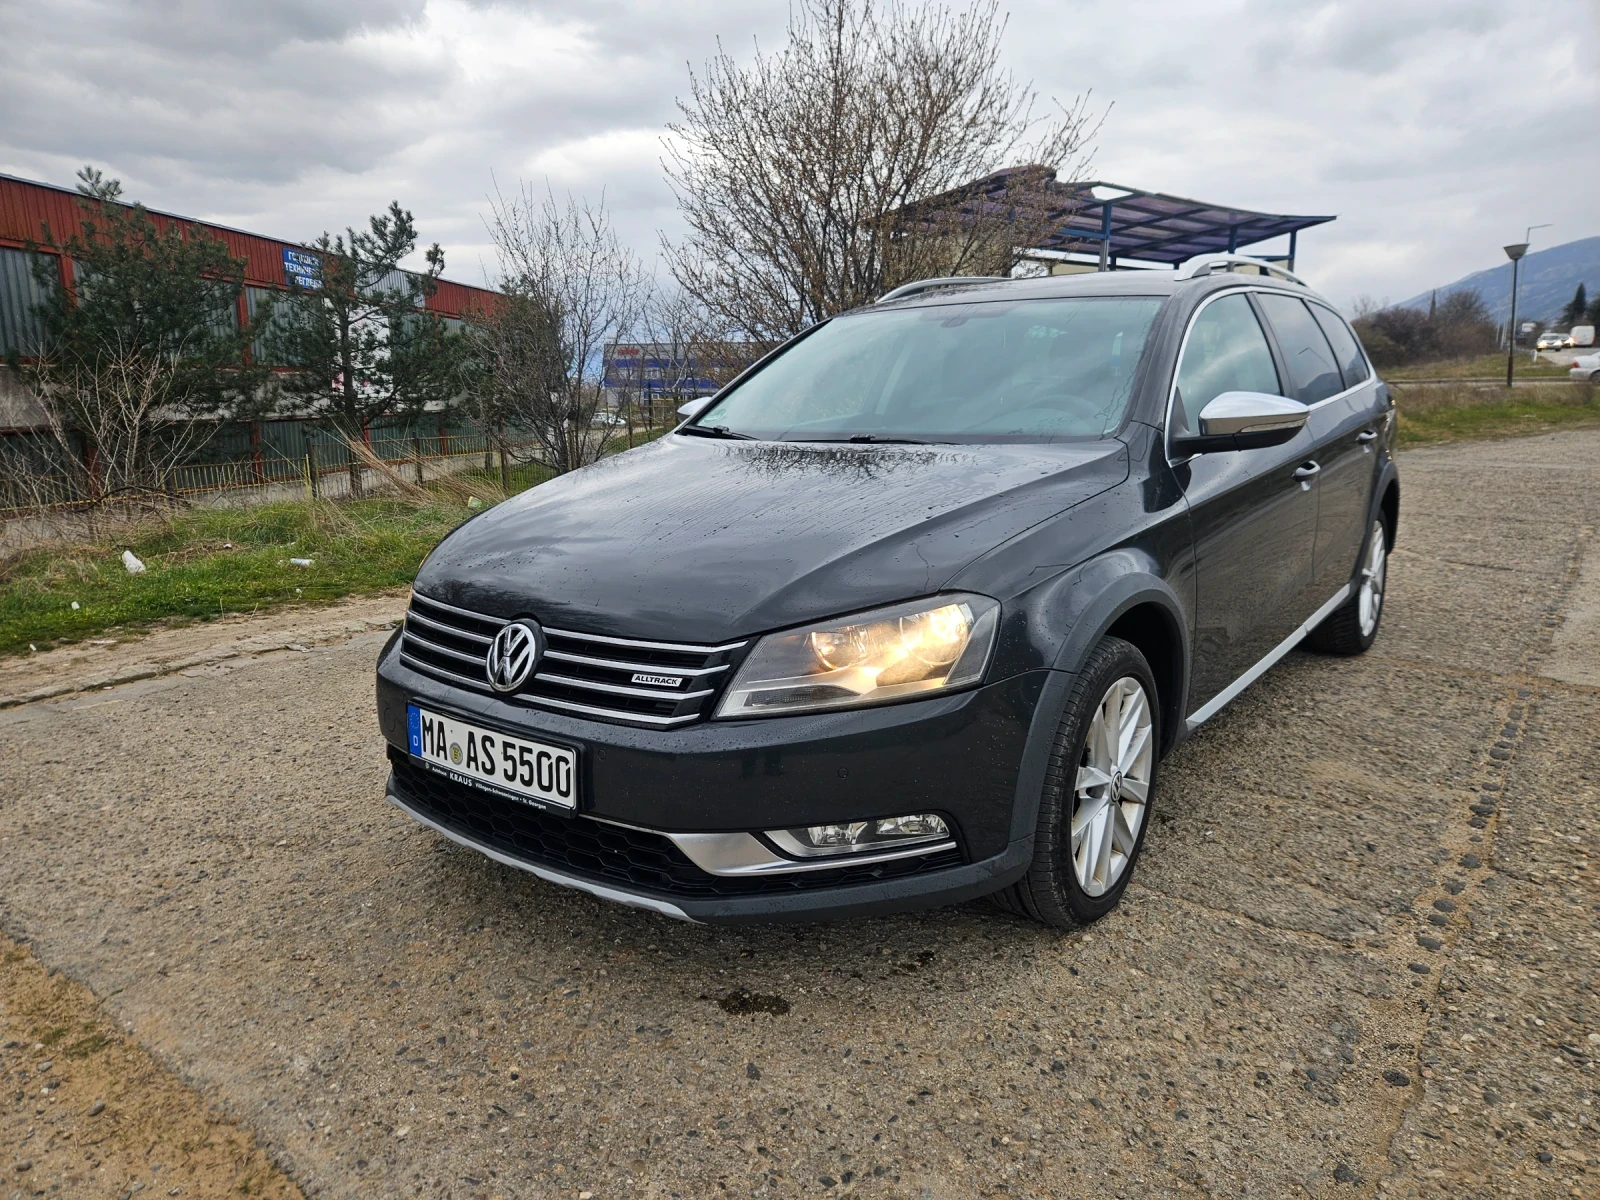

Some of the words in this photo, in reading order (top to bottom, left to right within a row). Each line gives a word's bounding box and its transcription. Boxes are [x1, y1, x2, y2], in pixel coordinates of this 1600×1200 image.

[284, 261, 323, 278] ТЕХНИЧЕ
[294, 275, 322, 289] РЕГЛЕД
[634, 675, 678, 685] ALLTRACK
[422, 715, 448, 761] MA
[466, 731, 496, 776] AS
[502, 740, 571, 798] 5500
[449, 772, 473, 787] KRAUS
